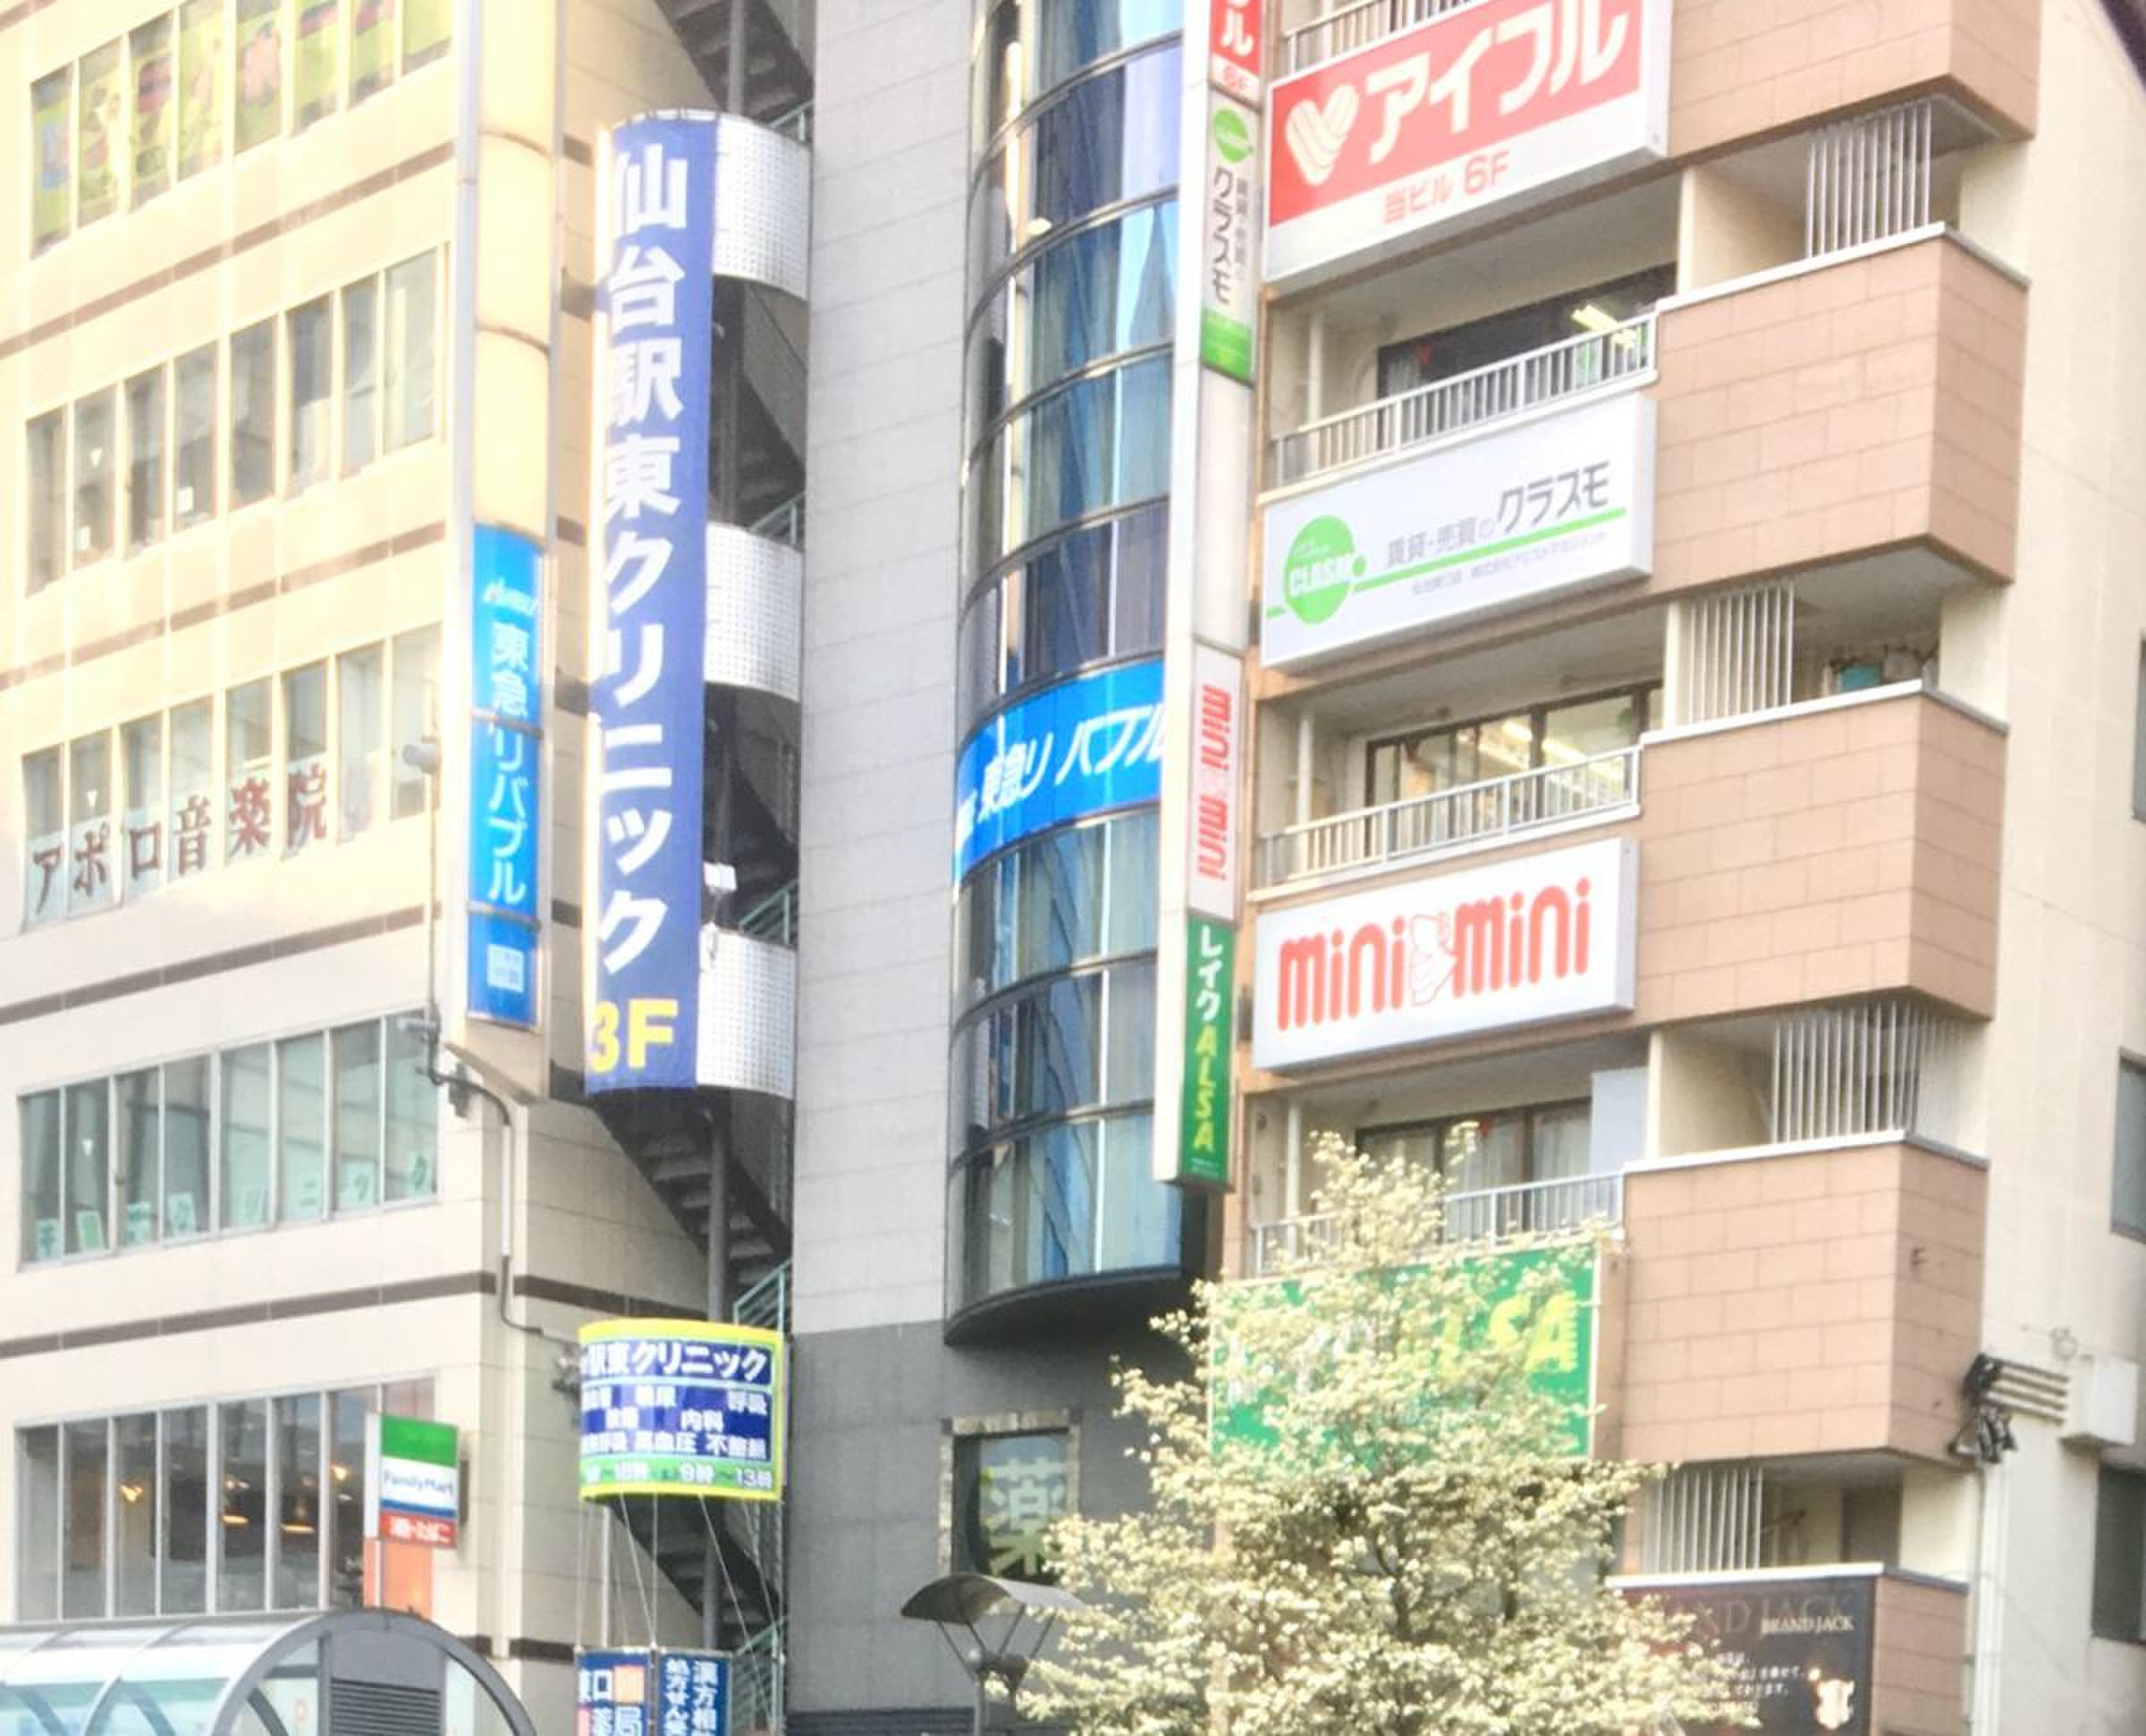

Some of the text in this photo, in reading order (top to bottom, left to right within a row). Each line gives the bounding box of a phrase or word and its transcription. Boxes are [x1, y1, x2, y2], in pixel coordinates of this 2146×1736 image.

[1364, 0, 1629, 165] アイフル
[1465, 150, 1509, 196] 6F
[604, 141, 689, 974] 仙台駅東クリニック
[32, 762, 329, 916] アポロ音楽院
[1195, 923, 1221, 1022] レイク
[1277, 876, 1592, 1031] mini mini
[580, 1340, 769, 1382] 駅東クリニック
